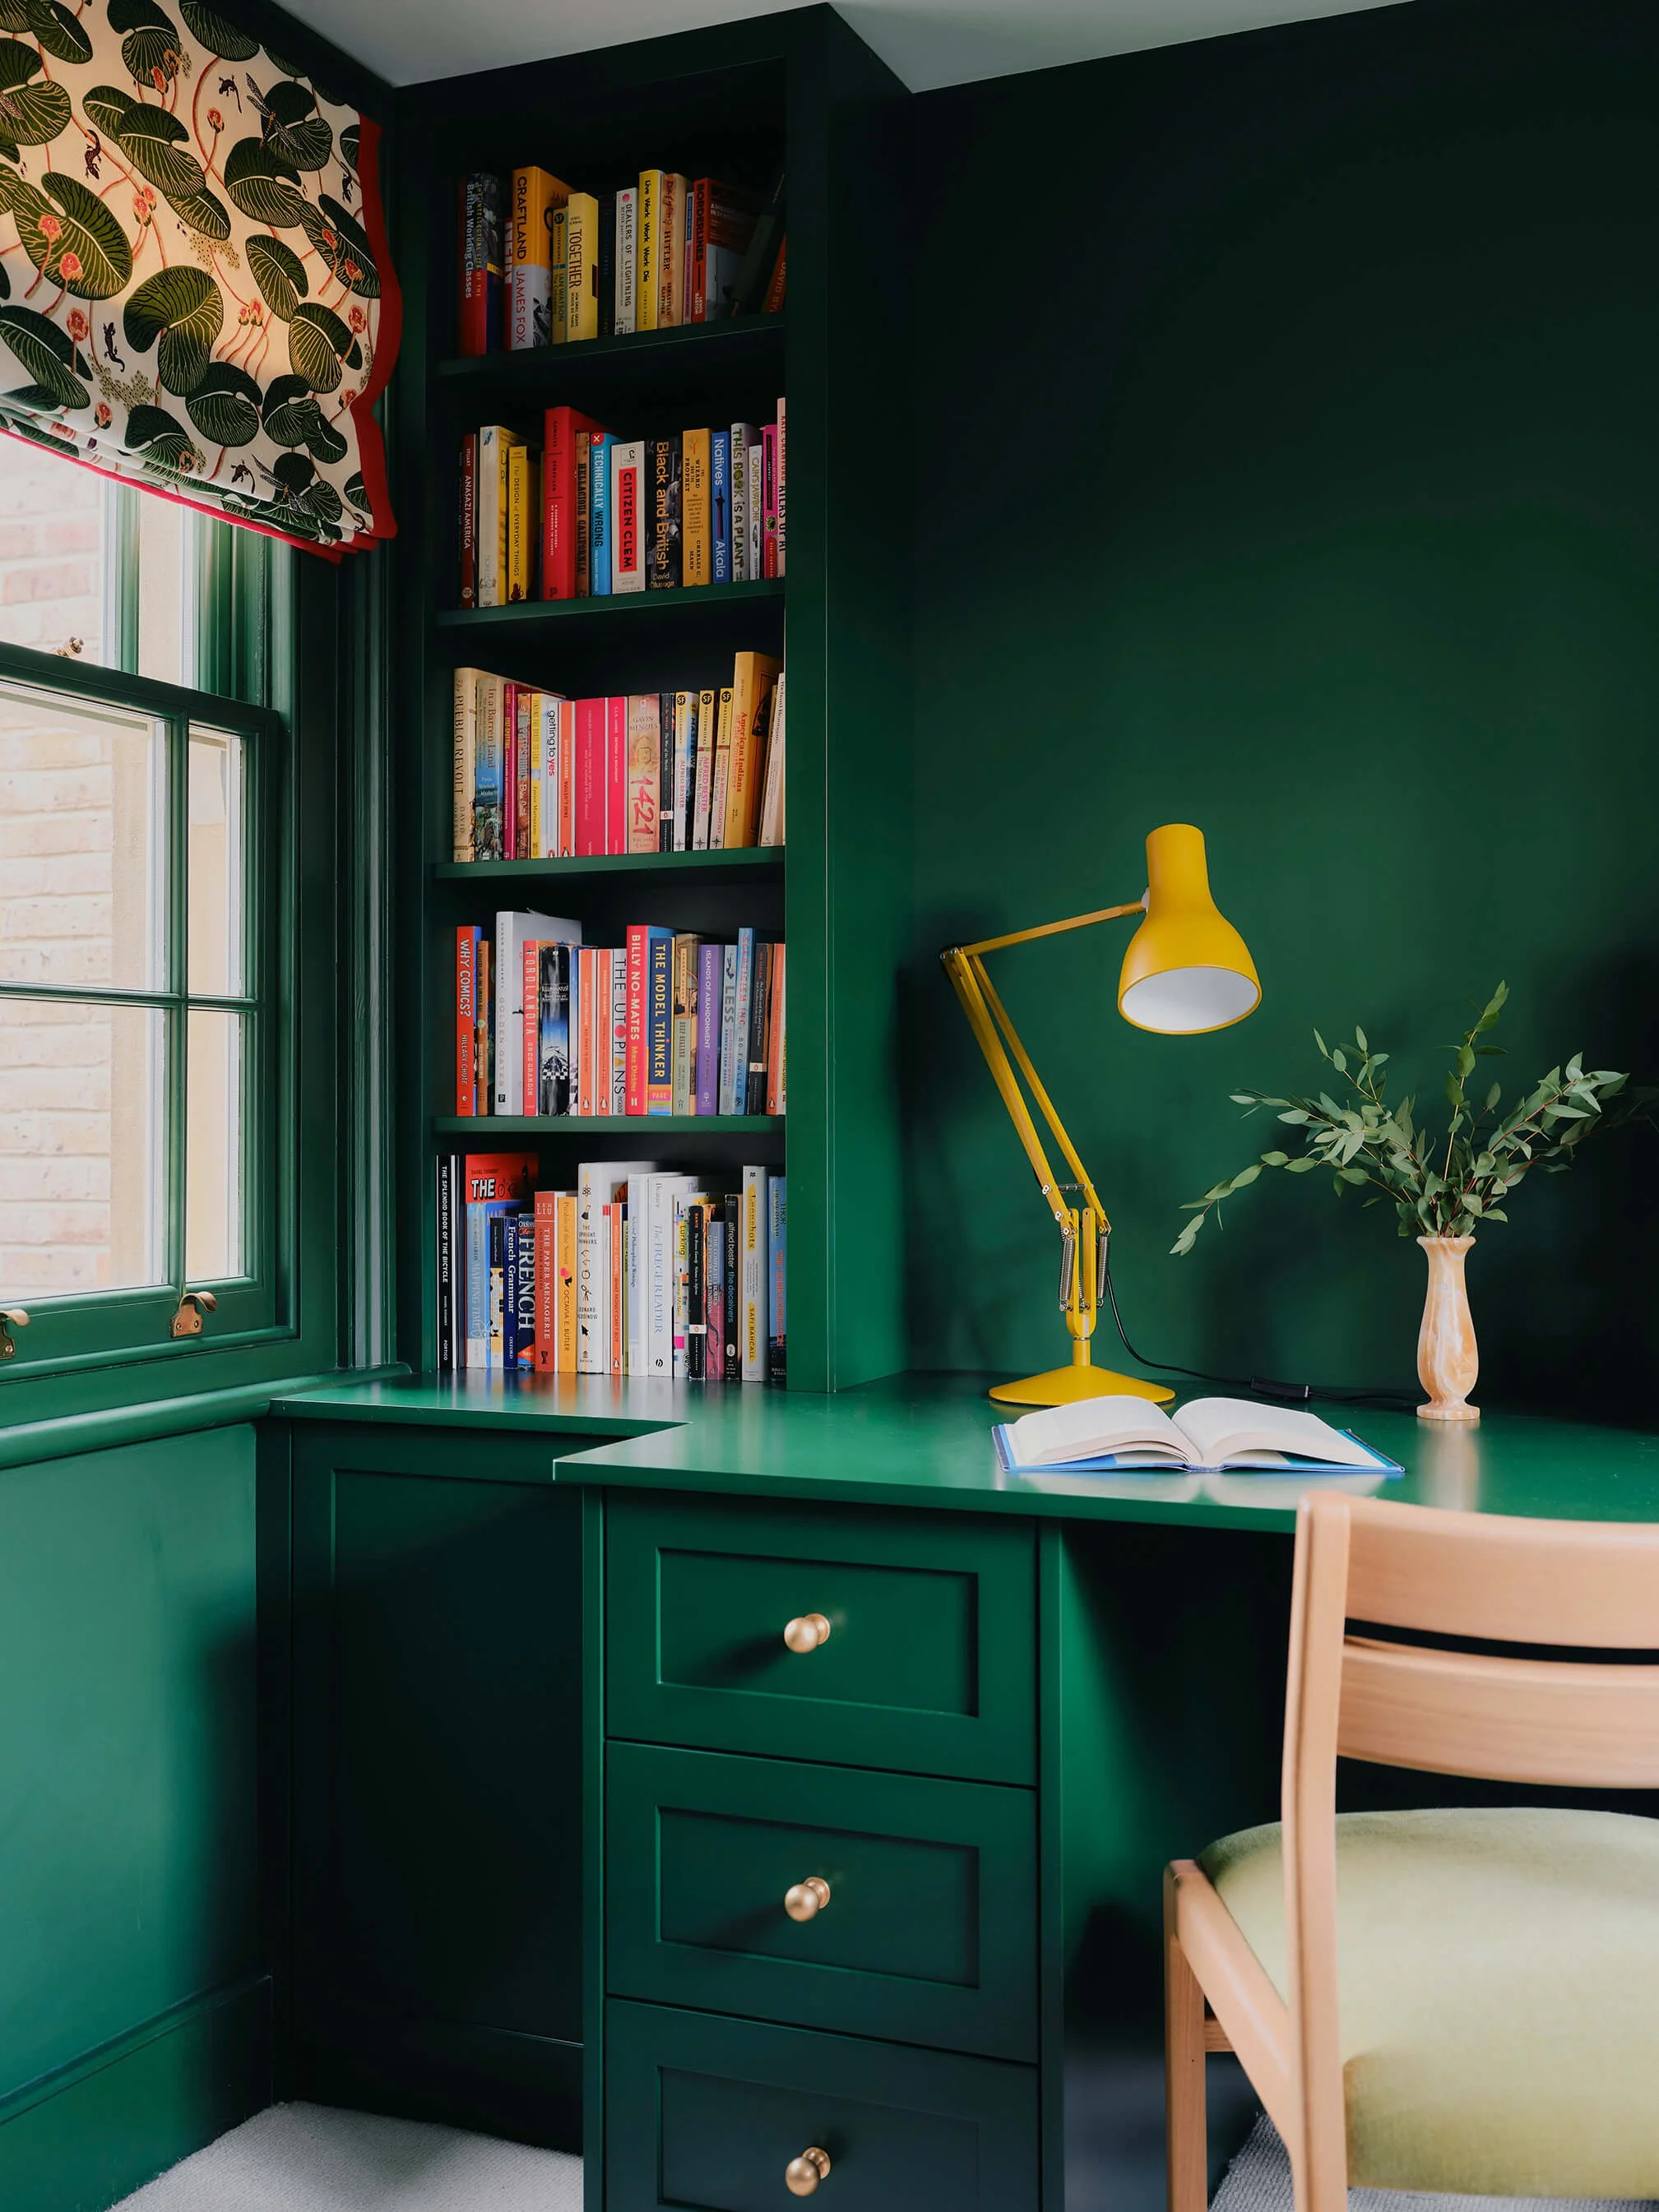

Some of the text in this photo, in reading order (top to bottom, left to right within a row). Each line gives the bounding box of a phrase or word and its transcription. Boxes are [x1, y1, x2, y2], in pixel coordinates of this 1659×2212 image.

[464, 183, 475, 299] British Working Classes
[517, 176, 526, 260] CRAFTLAND
[696, 183, 705, 263] BORDERLINES
[569, 229, 582, 289] TOGETHER
[625, 245, 632, 255] OF
[663, 230, 671, 271] HITLER
[516, 271, 525, 345] JAMES FOX
[464, 475, 472, 511] ANASAZI
[577, 462, 586, 515] HELLACIOUS
[594, 449, 604, 509] TECHNICALLY
[734, 462, 744, 498] BOOK
[594, 511, 604, 547] WRONG
[623, 472, 633, 568] CITIZEN CLEM
[656, 441, 670, 571] Black and British
[714, 437, 725, 578] Natives Akala
[734, 515, 742, 525] A
[734, 527, 743, 569] PLANT
[487, 687, 497, 699] In
[454, 696, 464, 794] PUEBLO REVOLT
[487, 709, 497, 742] Barren
[546, 710, 556, 776] getting to yes
[487, 743, 497, 769] Land
[731, 743, 739, 789] Southwest
[737, 712, 748, 793] American Indians
[631, 776, 655, 835] 1421
[459, 939, 471, 1016] WHY COMICS?
[614, 959, 626, 990] THE
[655, 944, 666, 968] THE
[526, 951, 536, 1034] FORDLANDIA
[630, 934, 641, 1040] BILLY NO-MATES
[655, 974, 665, 1016] MODEL
[704, 981, 711, 991] OF
[724, 986, 735, 1023] LESS
[470, 1178, 497, 1200] THE
[442, 1230, 448, 1240] OF
[727, 1222, 736, 1268] alfred bester
[508, 1225, 517, 1314] French Grammar
[518, 1235, 535, 1330] FRENCH
[655, 1242, 663, 1283] FREGE
[470, 1261, 482, 1330] MAPPING TIME
[655, 1286, 663, 1333] READER
[727, 1280, 735, 1322] deceivers
